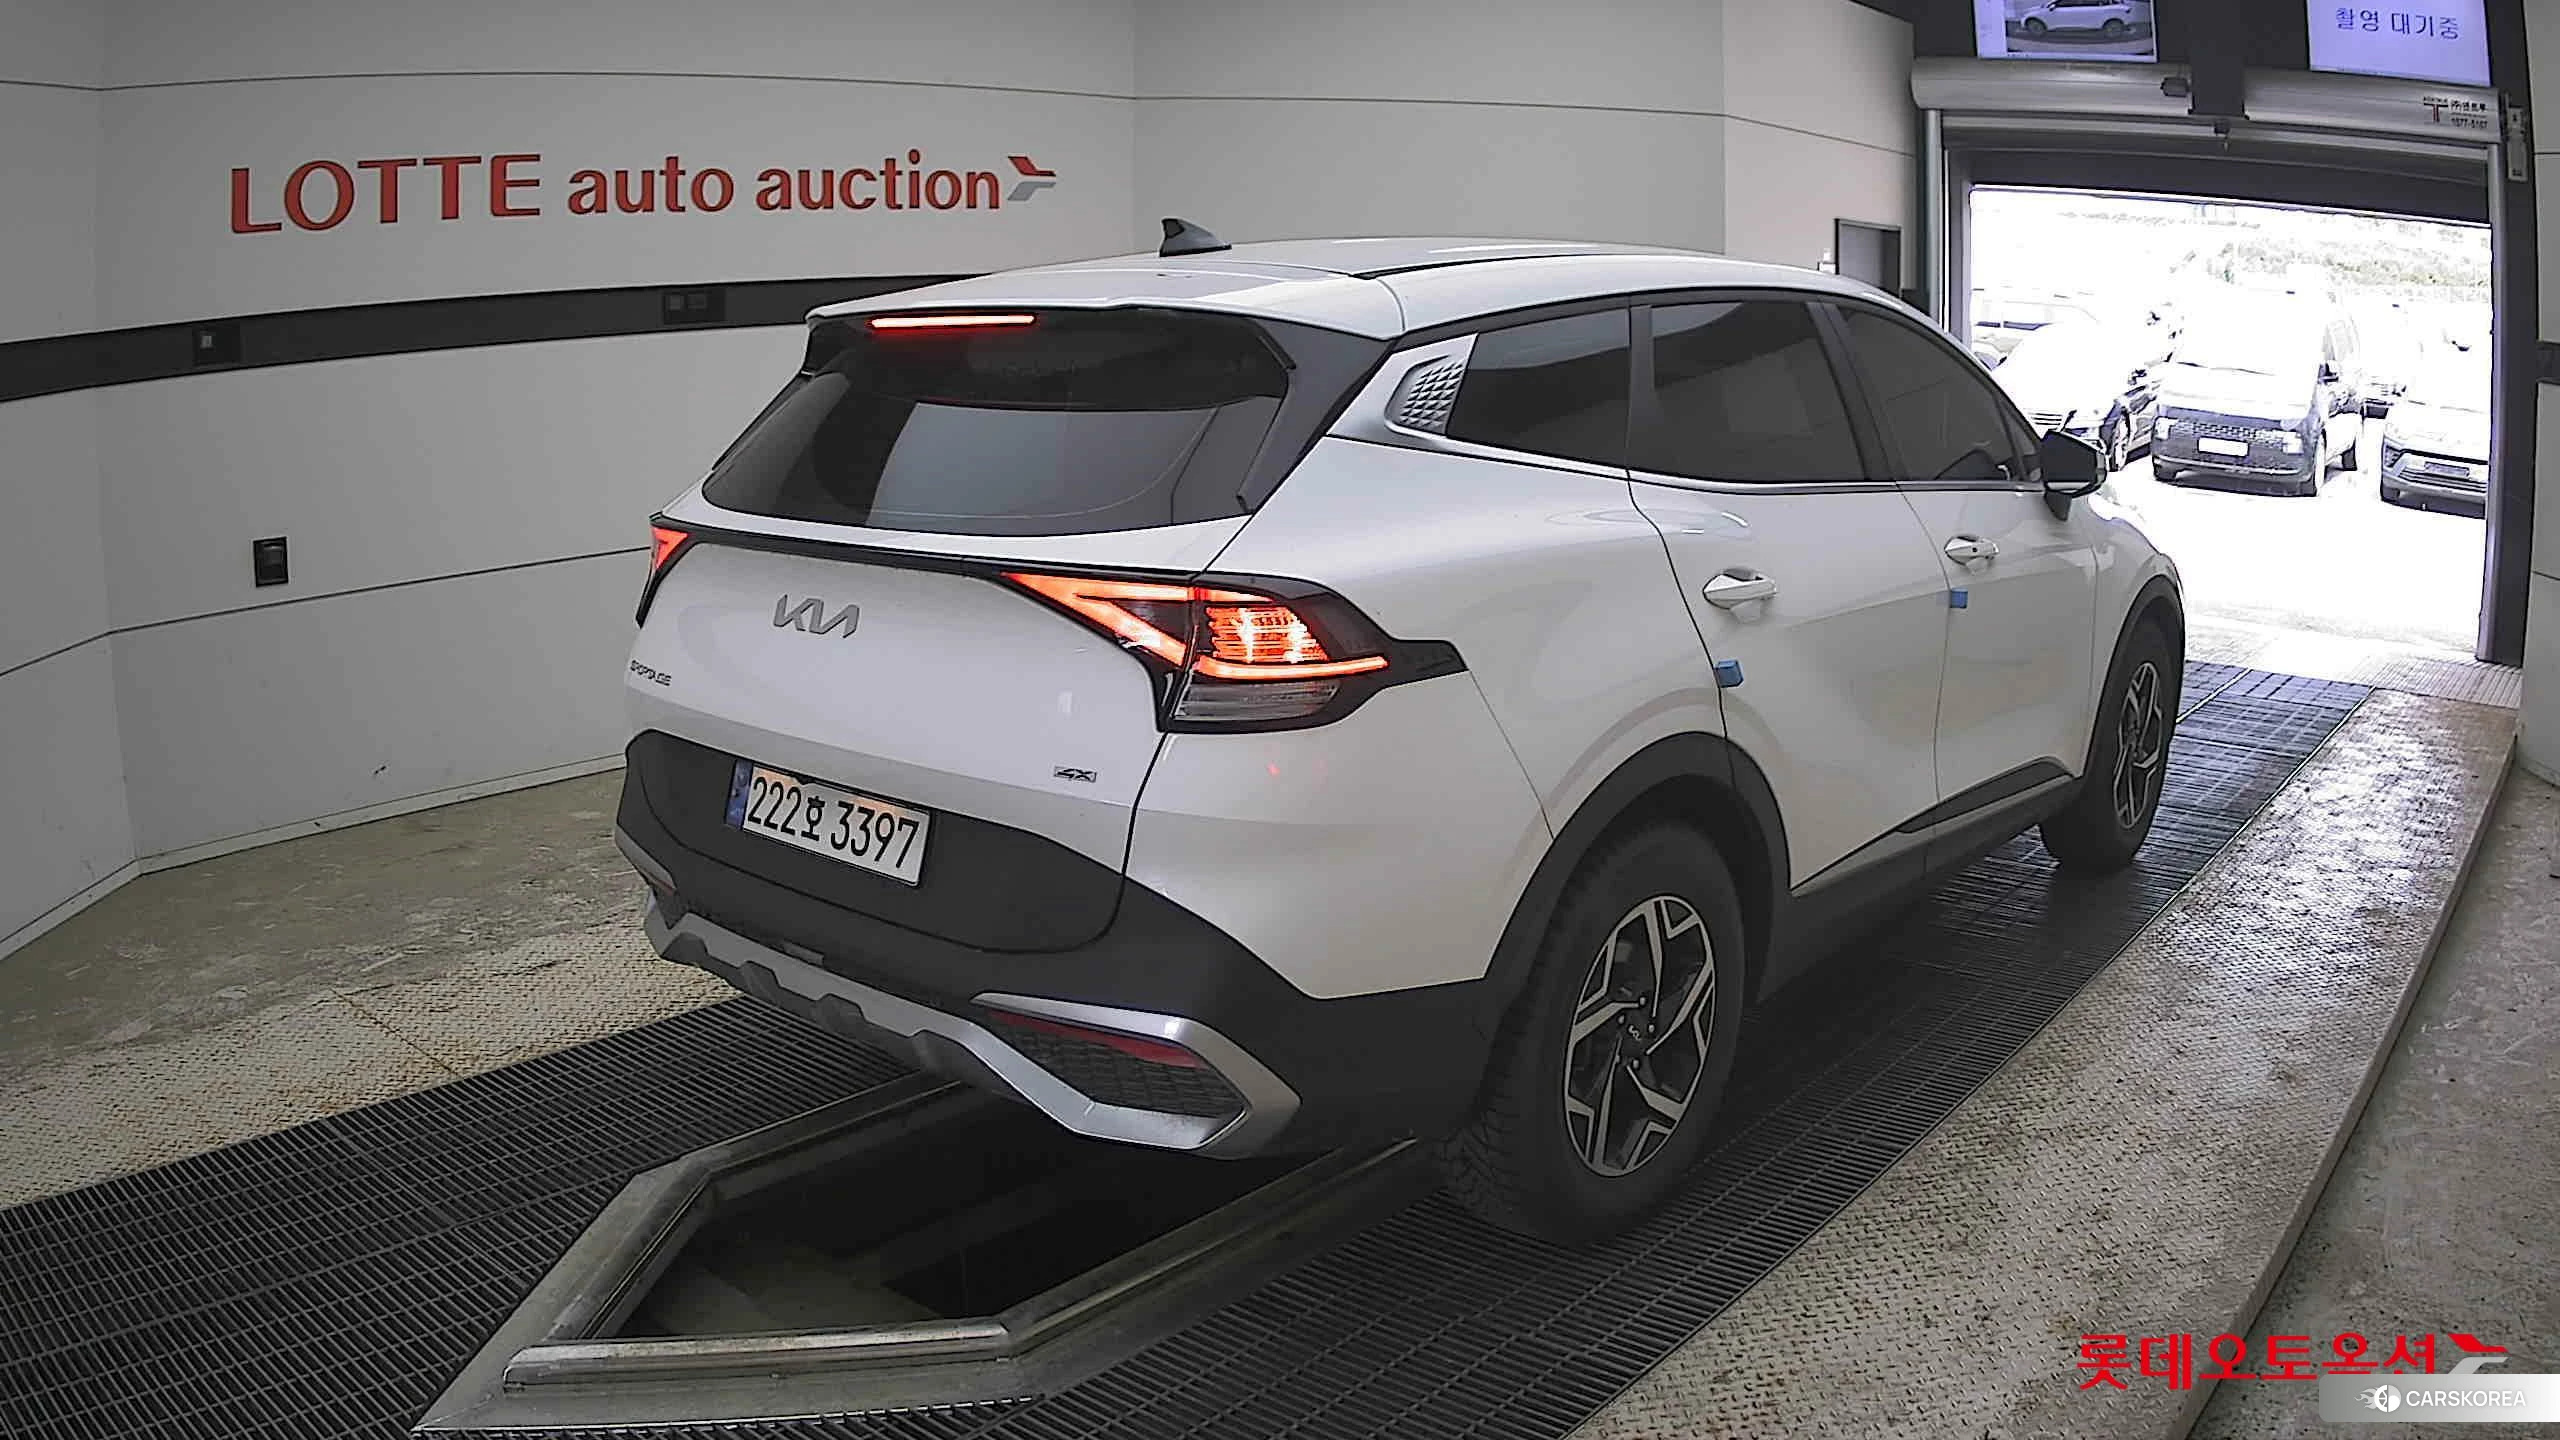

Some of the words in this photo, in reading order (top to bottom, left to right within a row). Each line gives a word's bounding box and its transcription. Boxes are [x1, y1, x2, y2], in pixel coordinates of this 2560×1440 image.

[2336, 8, 2379, 32] 촬영
[2391, 13, 2458, 40] 대기중
[231, 155, 541, 234] LOTTE
[568, 156, 735, 214] auto
[756, 150, 1001, 210] auction
[748, 776, 826, 842] 222호
[830, 800, 920, 869] 3397
